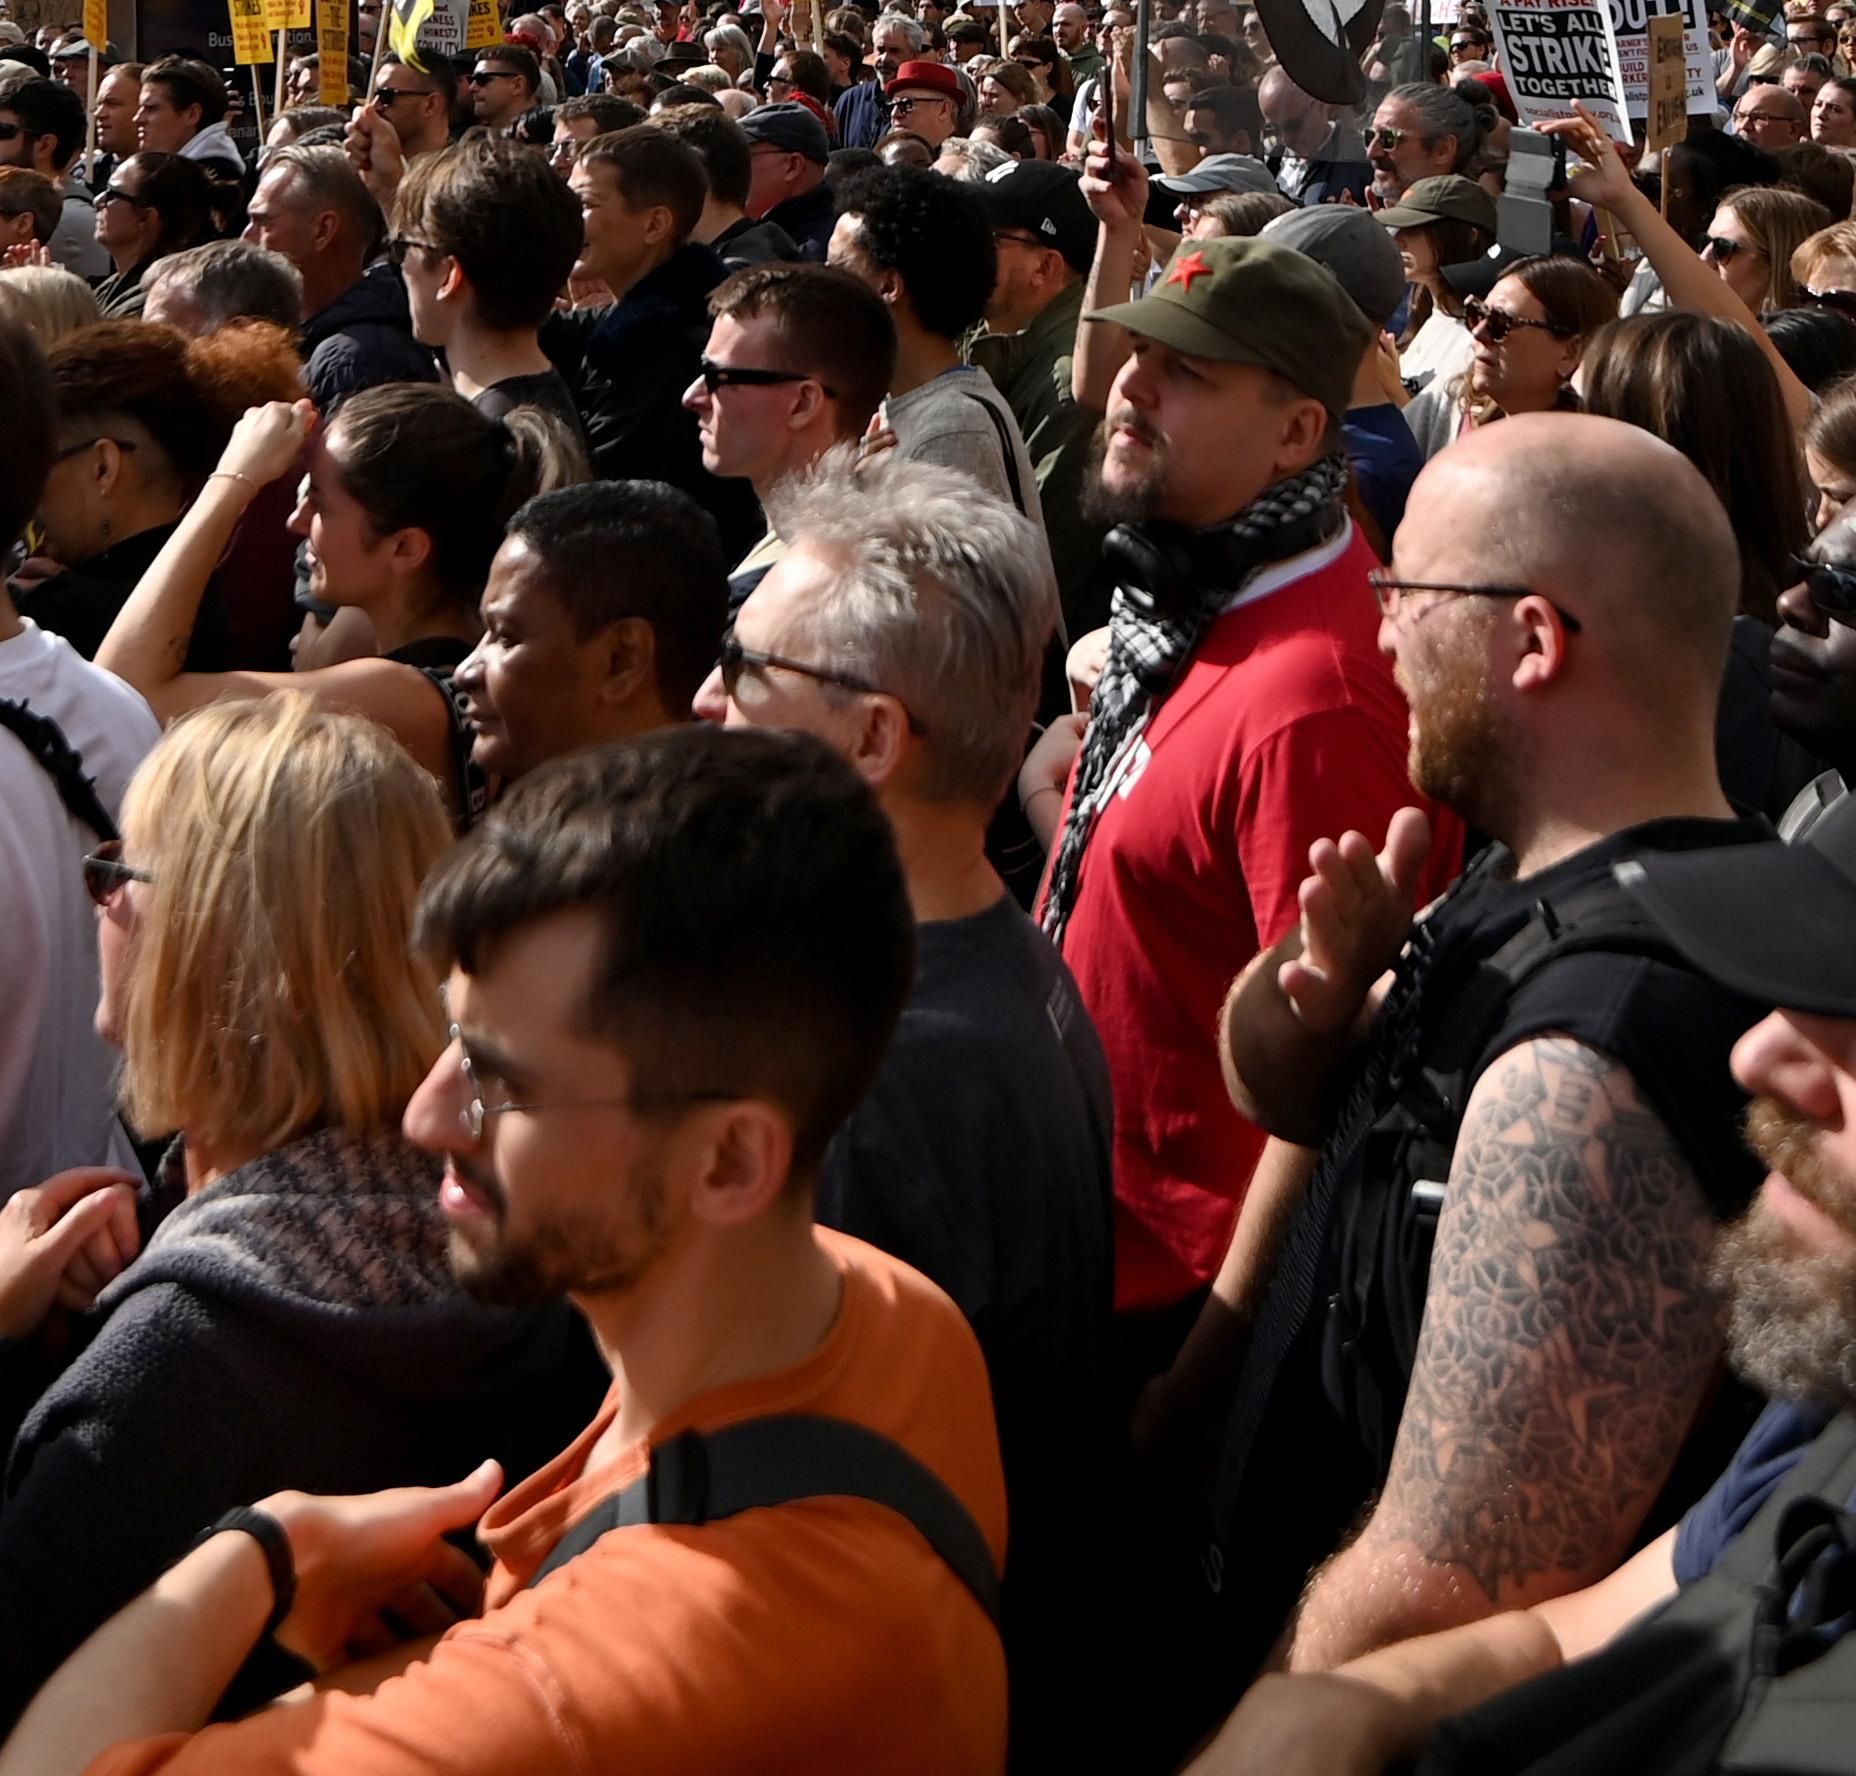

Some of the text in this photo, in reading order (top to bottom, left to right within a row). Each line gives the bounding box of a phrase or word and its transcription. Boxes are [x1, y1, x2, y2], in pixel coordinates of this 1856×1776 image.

[1496, 11, 1605, 36] LET'S ALL
[1506, 33, 1614, 78] STRIKE
[1685, 42, 1699, 52] US
[1620, 61, 1645, 73] UILD
[1514, 75, 1618, 103] TOGETHER
